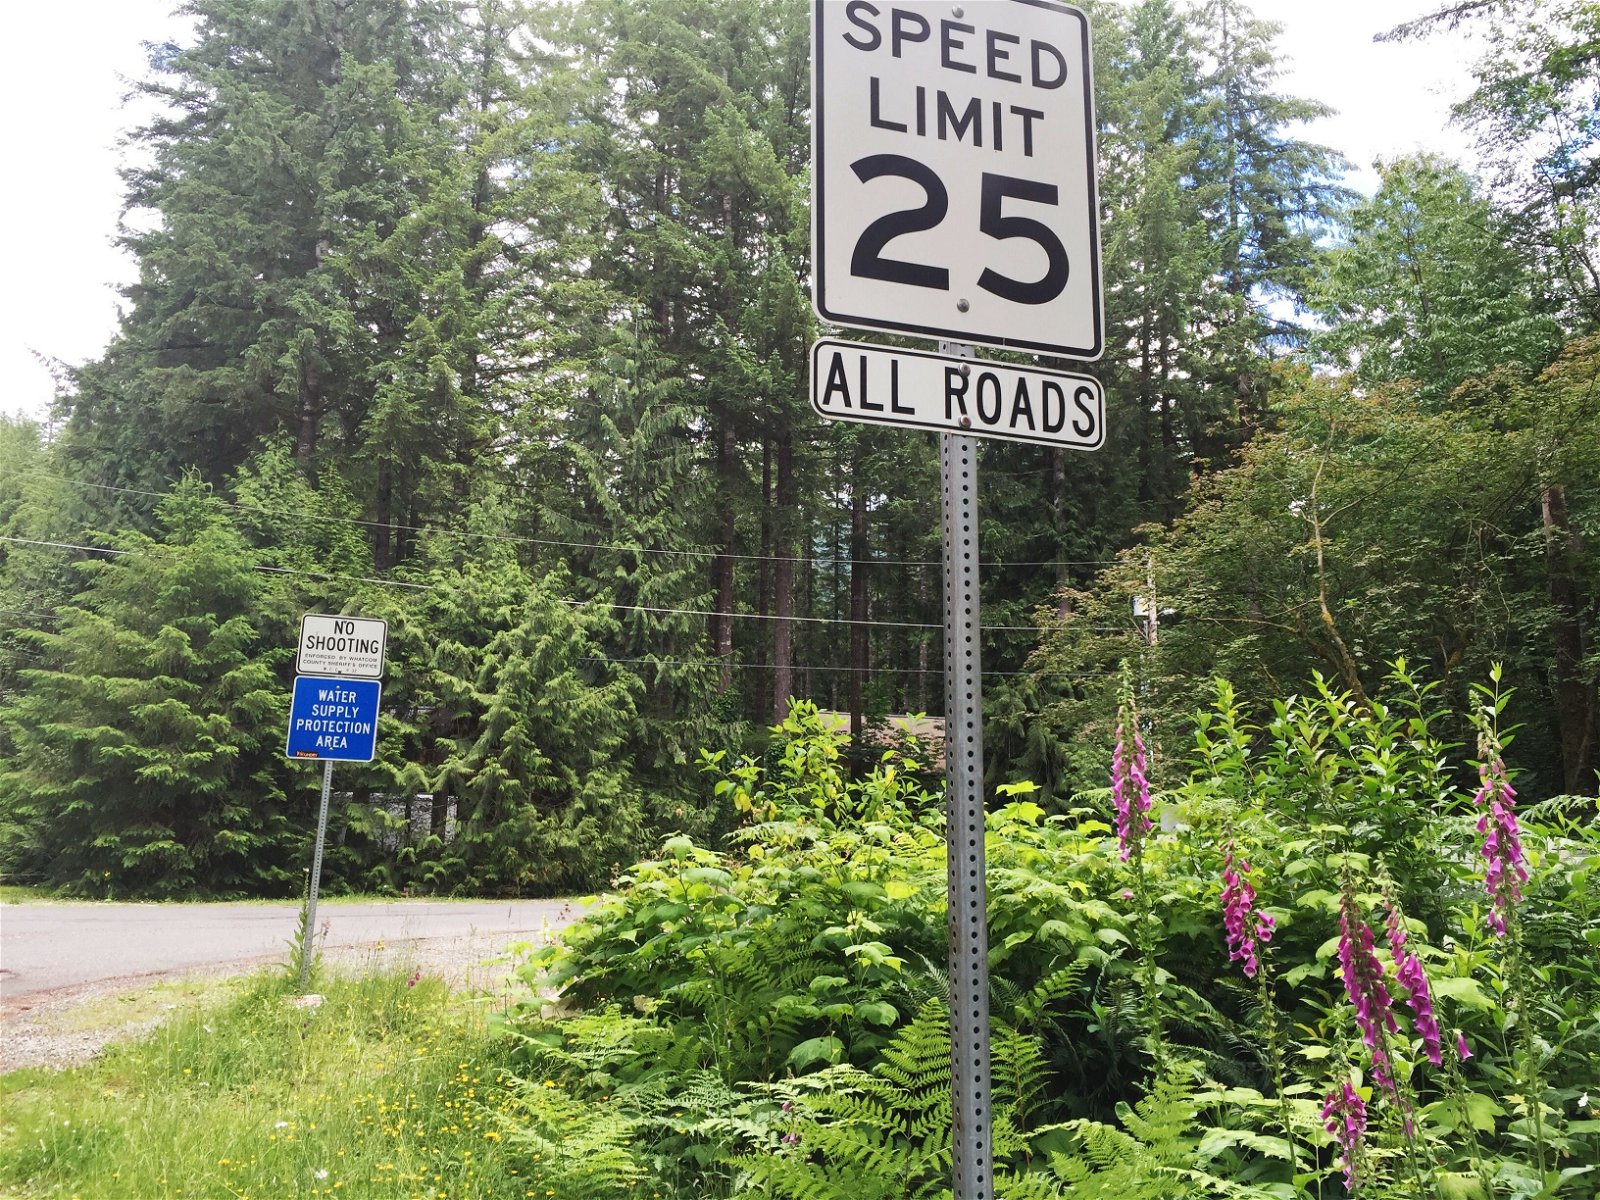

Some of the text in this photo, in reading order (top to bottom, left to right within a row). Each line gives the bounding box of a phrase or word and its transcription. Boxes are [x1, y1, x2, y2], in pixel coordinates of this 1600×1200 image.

[842, 0, 1067, 90] SPEED
[870, 76, 1044, 157] LIMIT
[849, 153, 1070, 305] 25
[822, 351, 1095, 438] ALL ROADS
[334, 620, 355, 636] NO
[306, 635, 379, 654] SHOOTING
[318, 689, 356, 703] WATER
[312, 704, 359, 718] SUPPLY
[296, 718, 370, 734] PROTECTION
[316, 735, 347, 749] AREA
